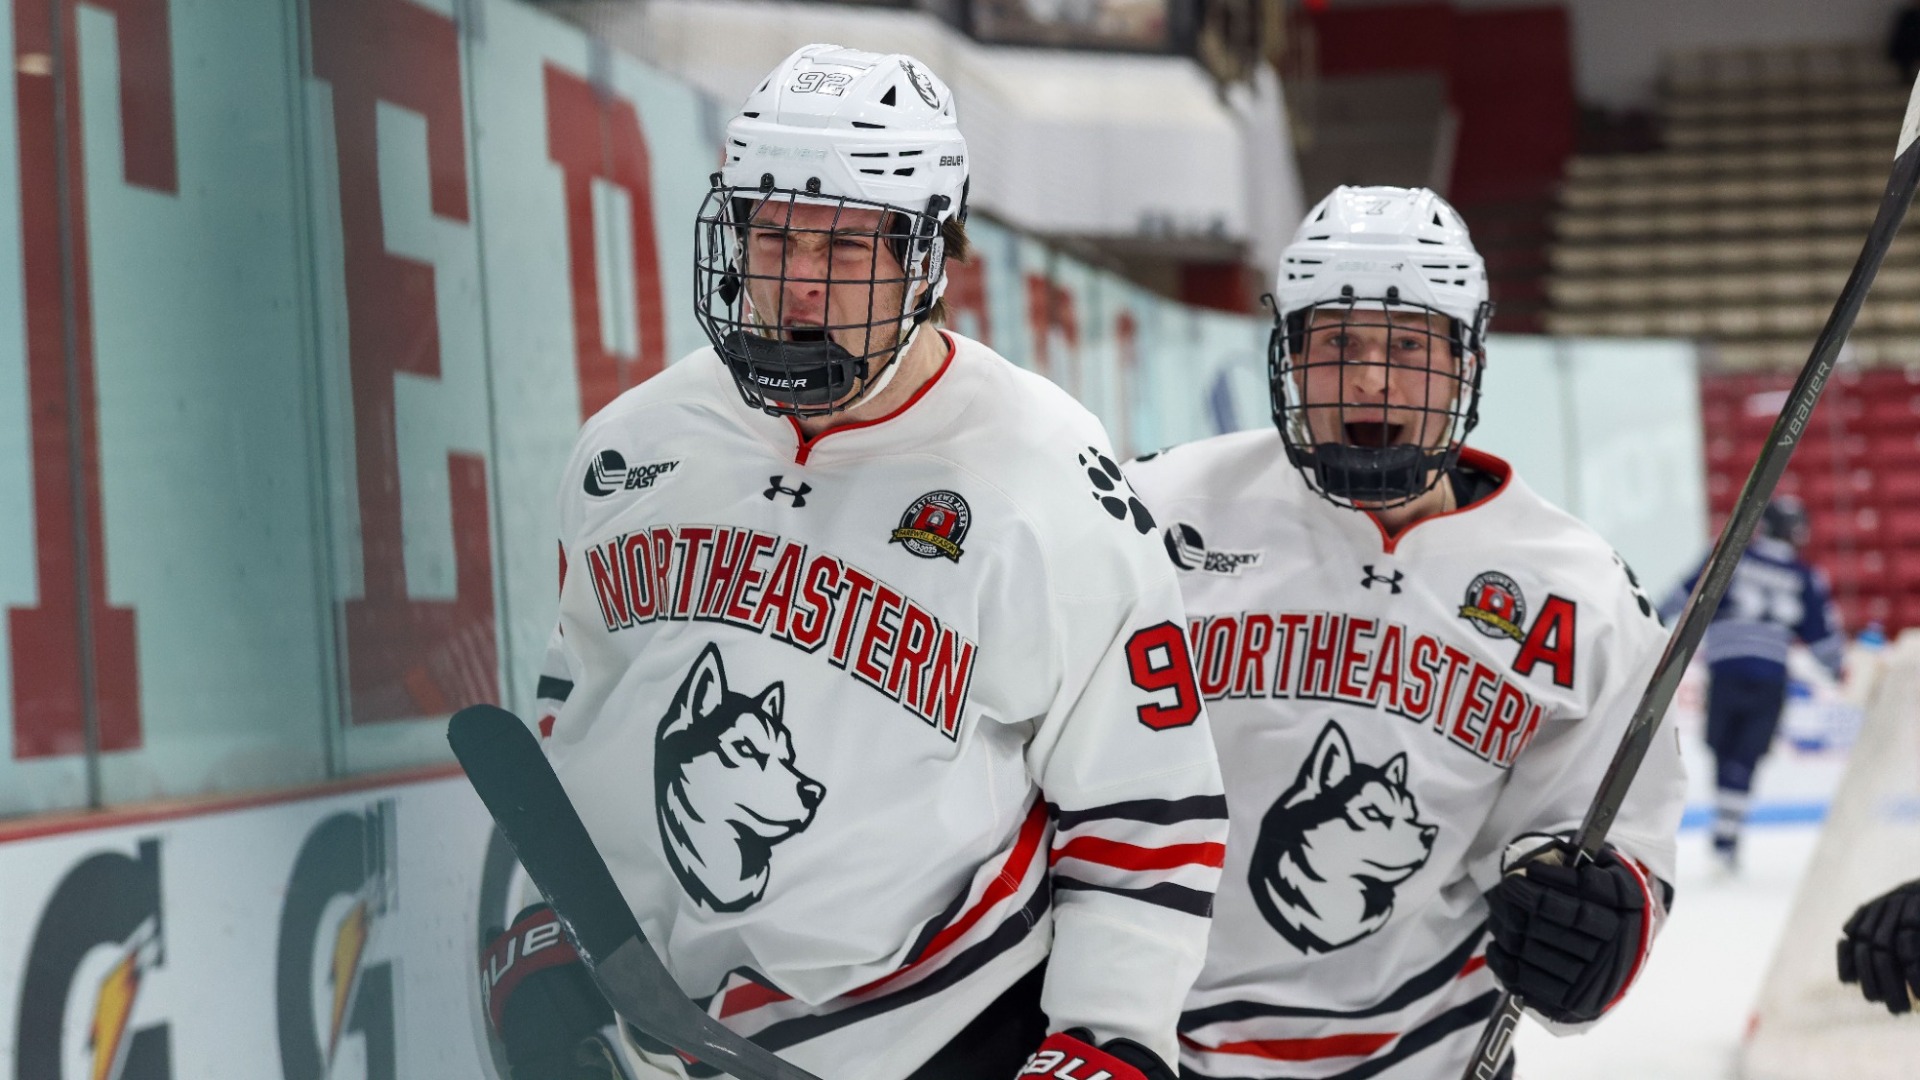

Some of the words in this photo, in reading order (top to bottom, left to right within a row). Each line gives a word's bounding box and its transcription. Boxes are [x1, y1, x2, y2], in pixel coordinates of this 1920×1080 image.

[791, 71, 853, 96] 92
[624, 475, 658, 490] EAST
[627, 460, 680, 480] HOCKEY
[910, 494, 956, 515] MATTHEWS
[953, 502, 967, 528] ARENA
[1203, 561, 1238, 573] EAST
[1206, 551, 1260, 565] HOCKEY
[584, 523, 979, 742] NORTHEASTERN
[1512, 593, 1577, 690] A
[1125, 620, 1202, 731] 9
